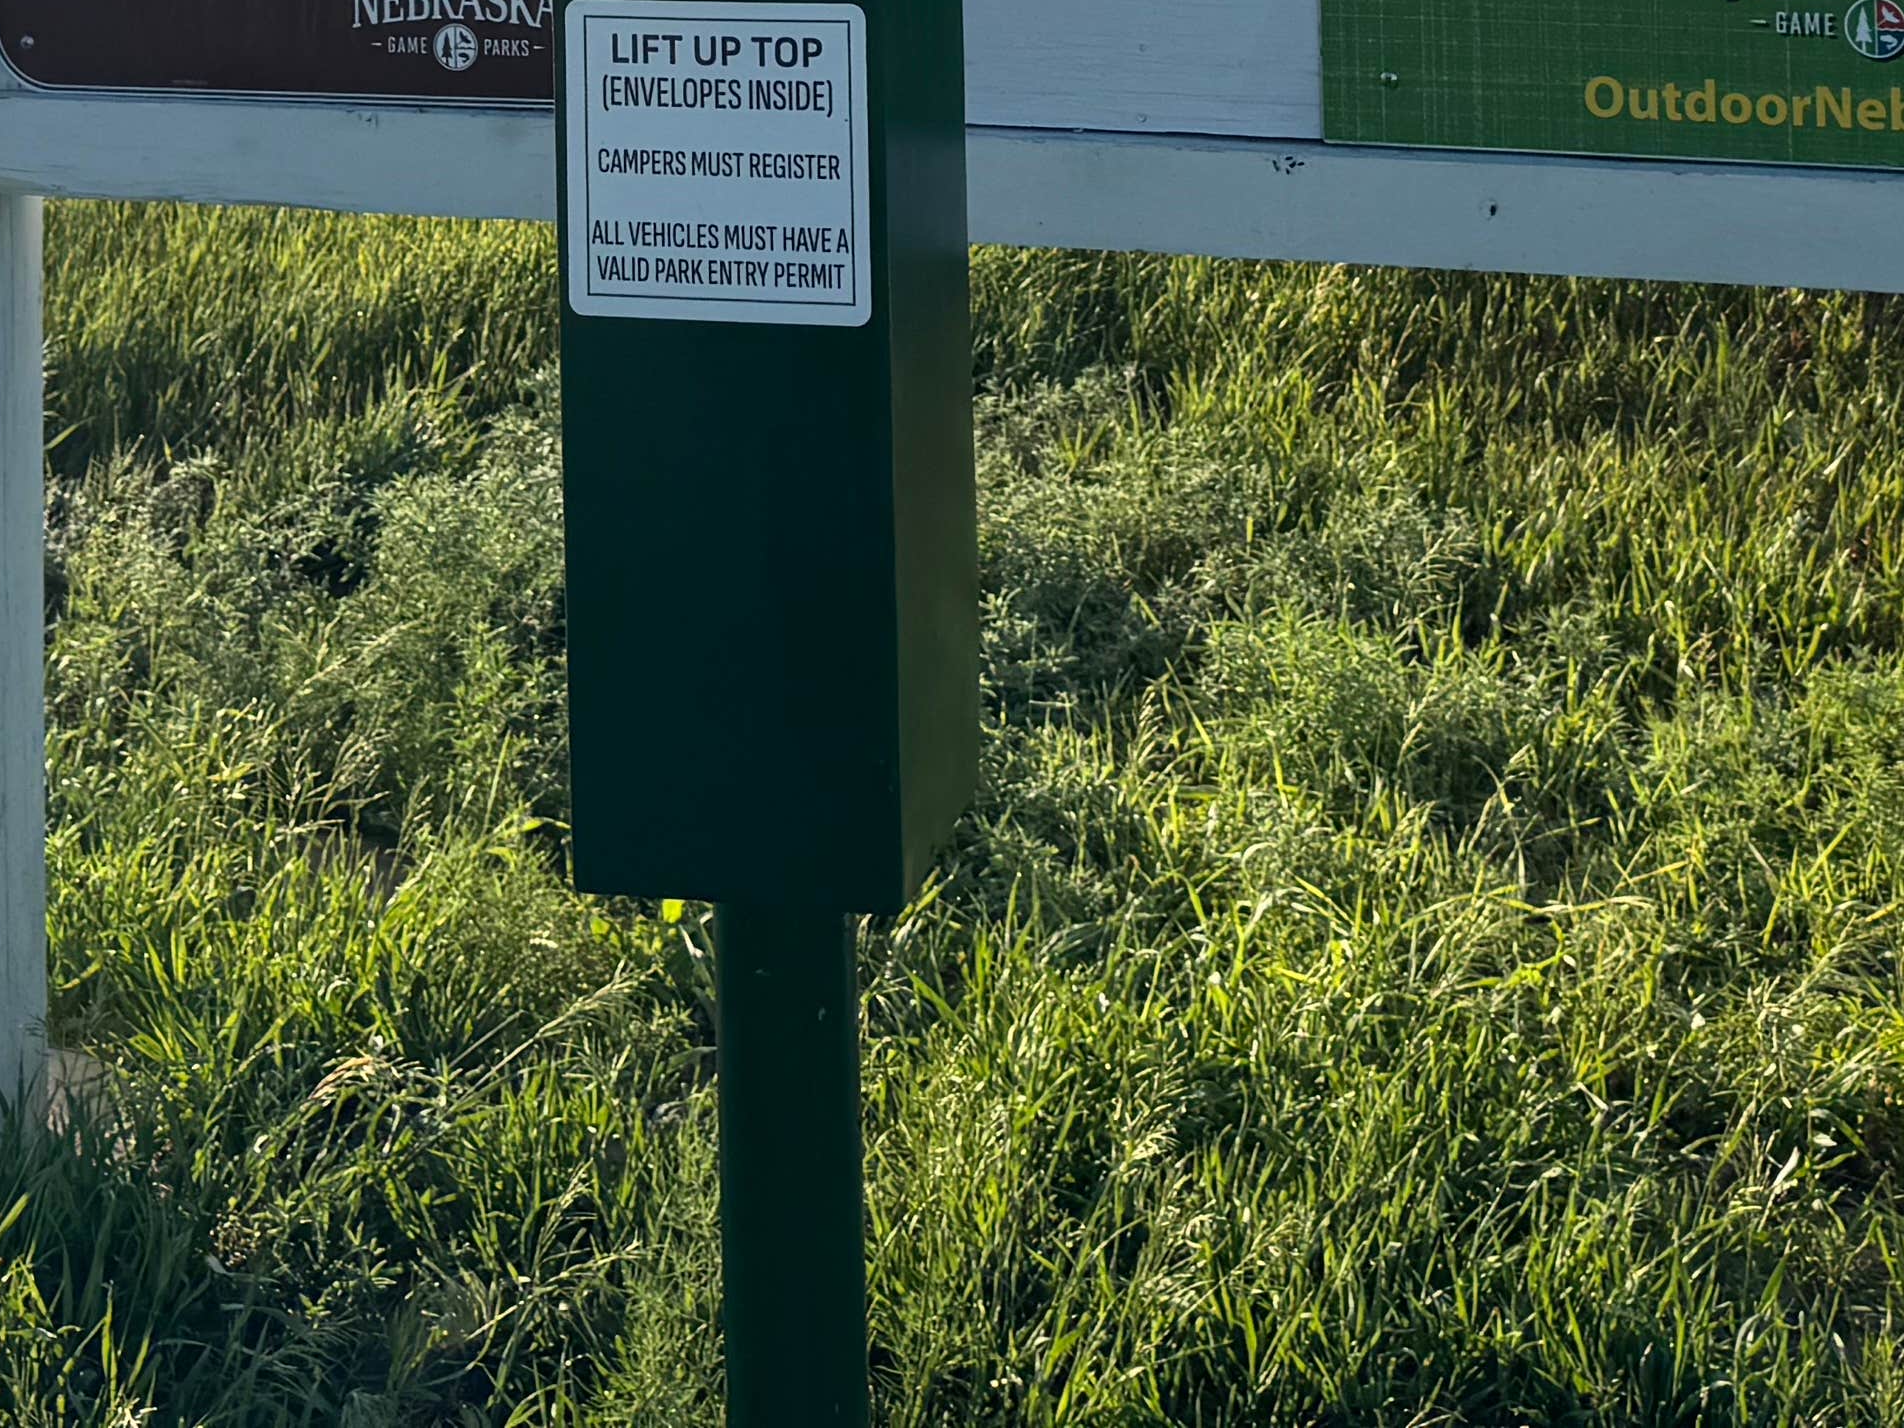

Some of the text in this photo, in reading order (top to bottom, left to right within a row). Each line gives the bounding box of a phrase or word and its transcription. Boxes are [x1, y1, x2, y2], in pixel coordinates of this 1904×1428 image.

[1775, 12, 1835, 36] GAME
[387, 36, 529, 56] GAME PARKS
[612, 34, 822, 67] LIFT UP TOP
[603, 76, 832, 116] (ENVELOPES INSIDE)
[598, 149, 839, 179] CAMPERS MUST REGISTER
[592, 220, 848, 253] ALL VEHICLES MUST HAVE A
[597, 256, 844, 288] VALID PARK ENTRY PERMIT
